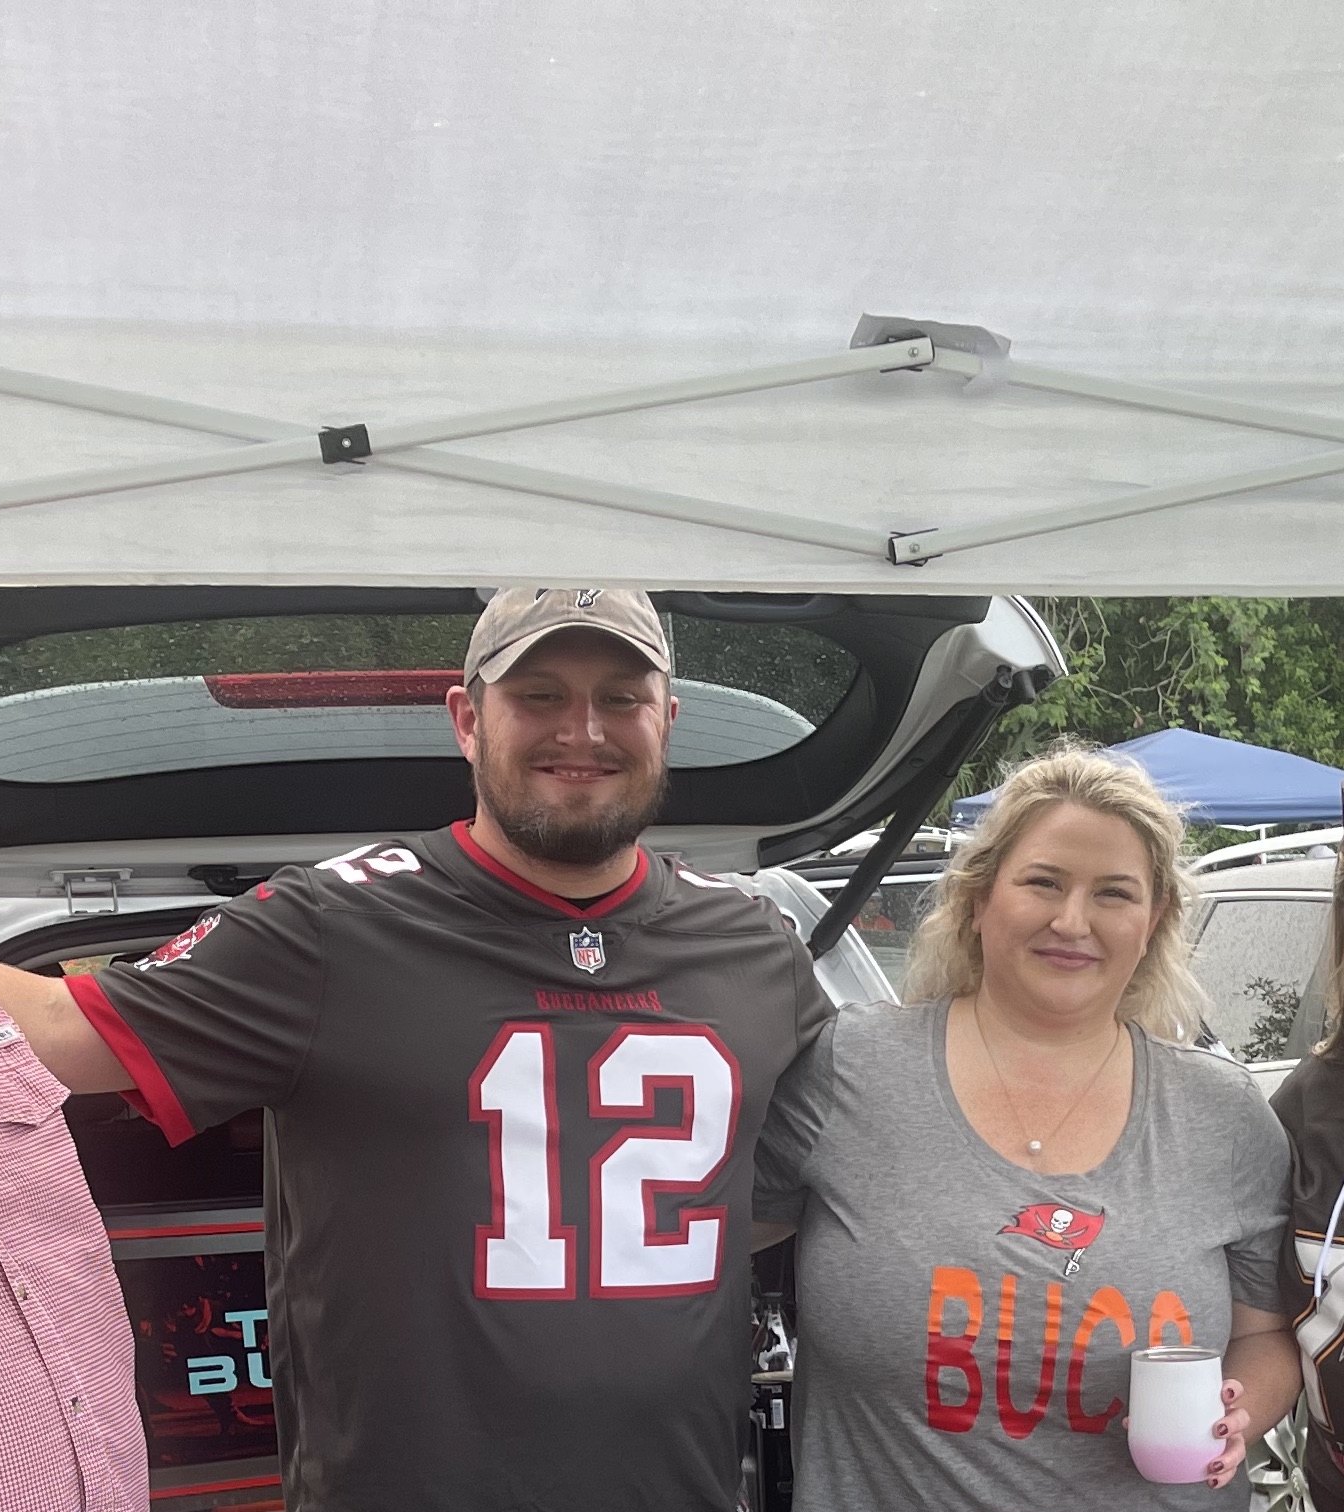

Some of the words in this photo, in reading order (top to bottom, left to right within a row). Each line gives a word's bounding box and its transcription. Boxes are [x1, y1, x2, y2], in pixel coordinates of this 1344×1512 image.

[576, 948, 601, 965] NFL
[535, 988, 663, 1013] BUCCANEERS
[467, 1020, 742, 1301] 12
[187, 1353, 274, 1396] BU
